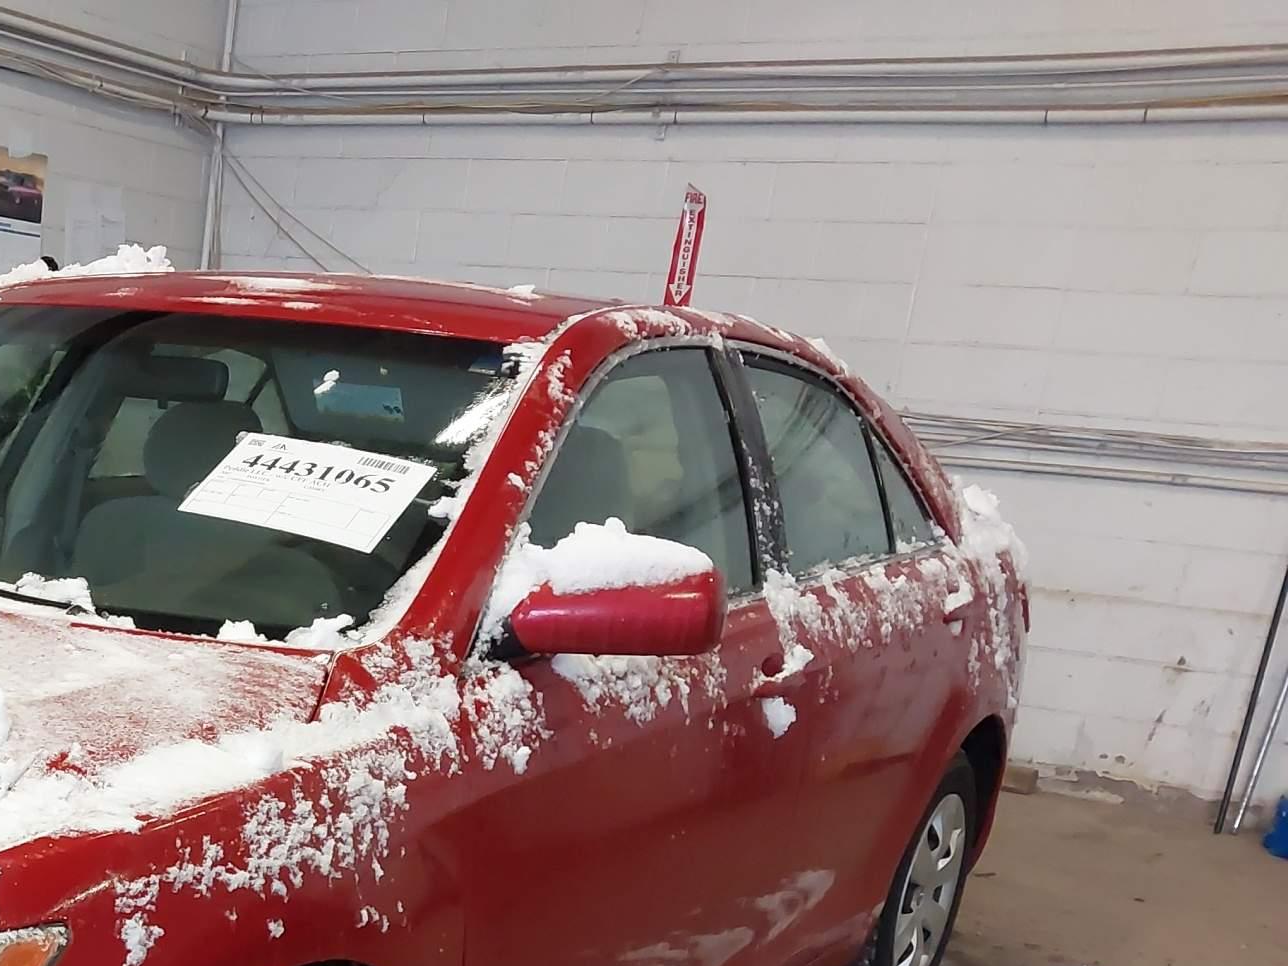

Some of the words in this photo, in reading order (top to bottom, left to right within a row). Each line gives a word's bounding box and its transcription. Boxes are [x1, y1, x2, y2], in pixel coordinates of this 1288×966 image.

[685, 191, 704, 205] FIRE
[674, 209, 696, 297] EXTINGUISHER
[241, 453, 396, 494] 44431065
